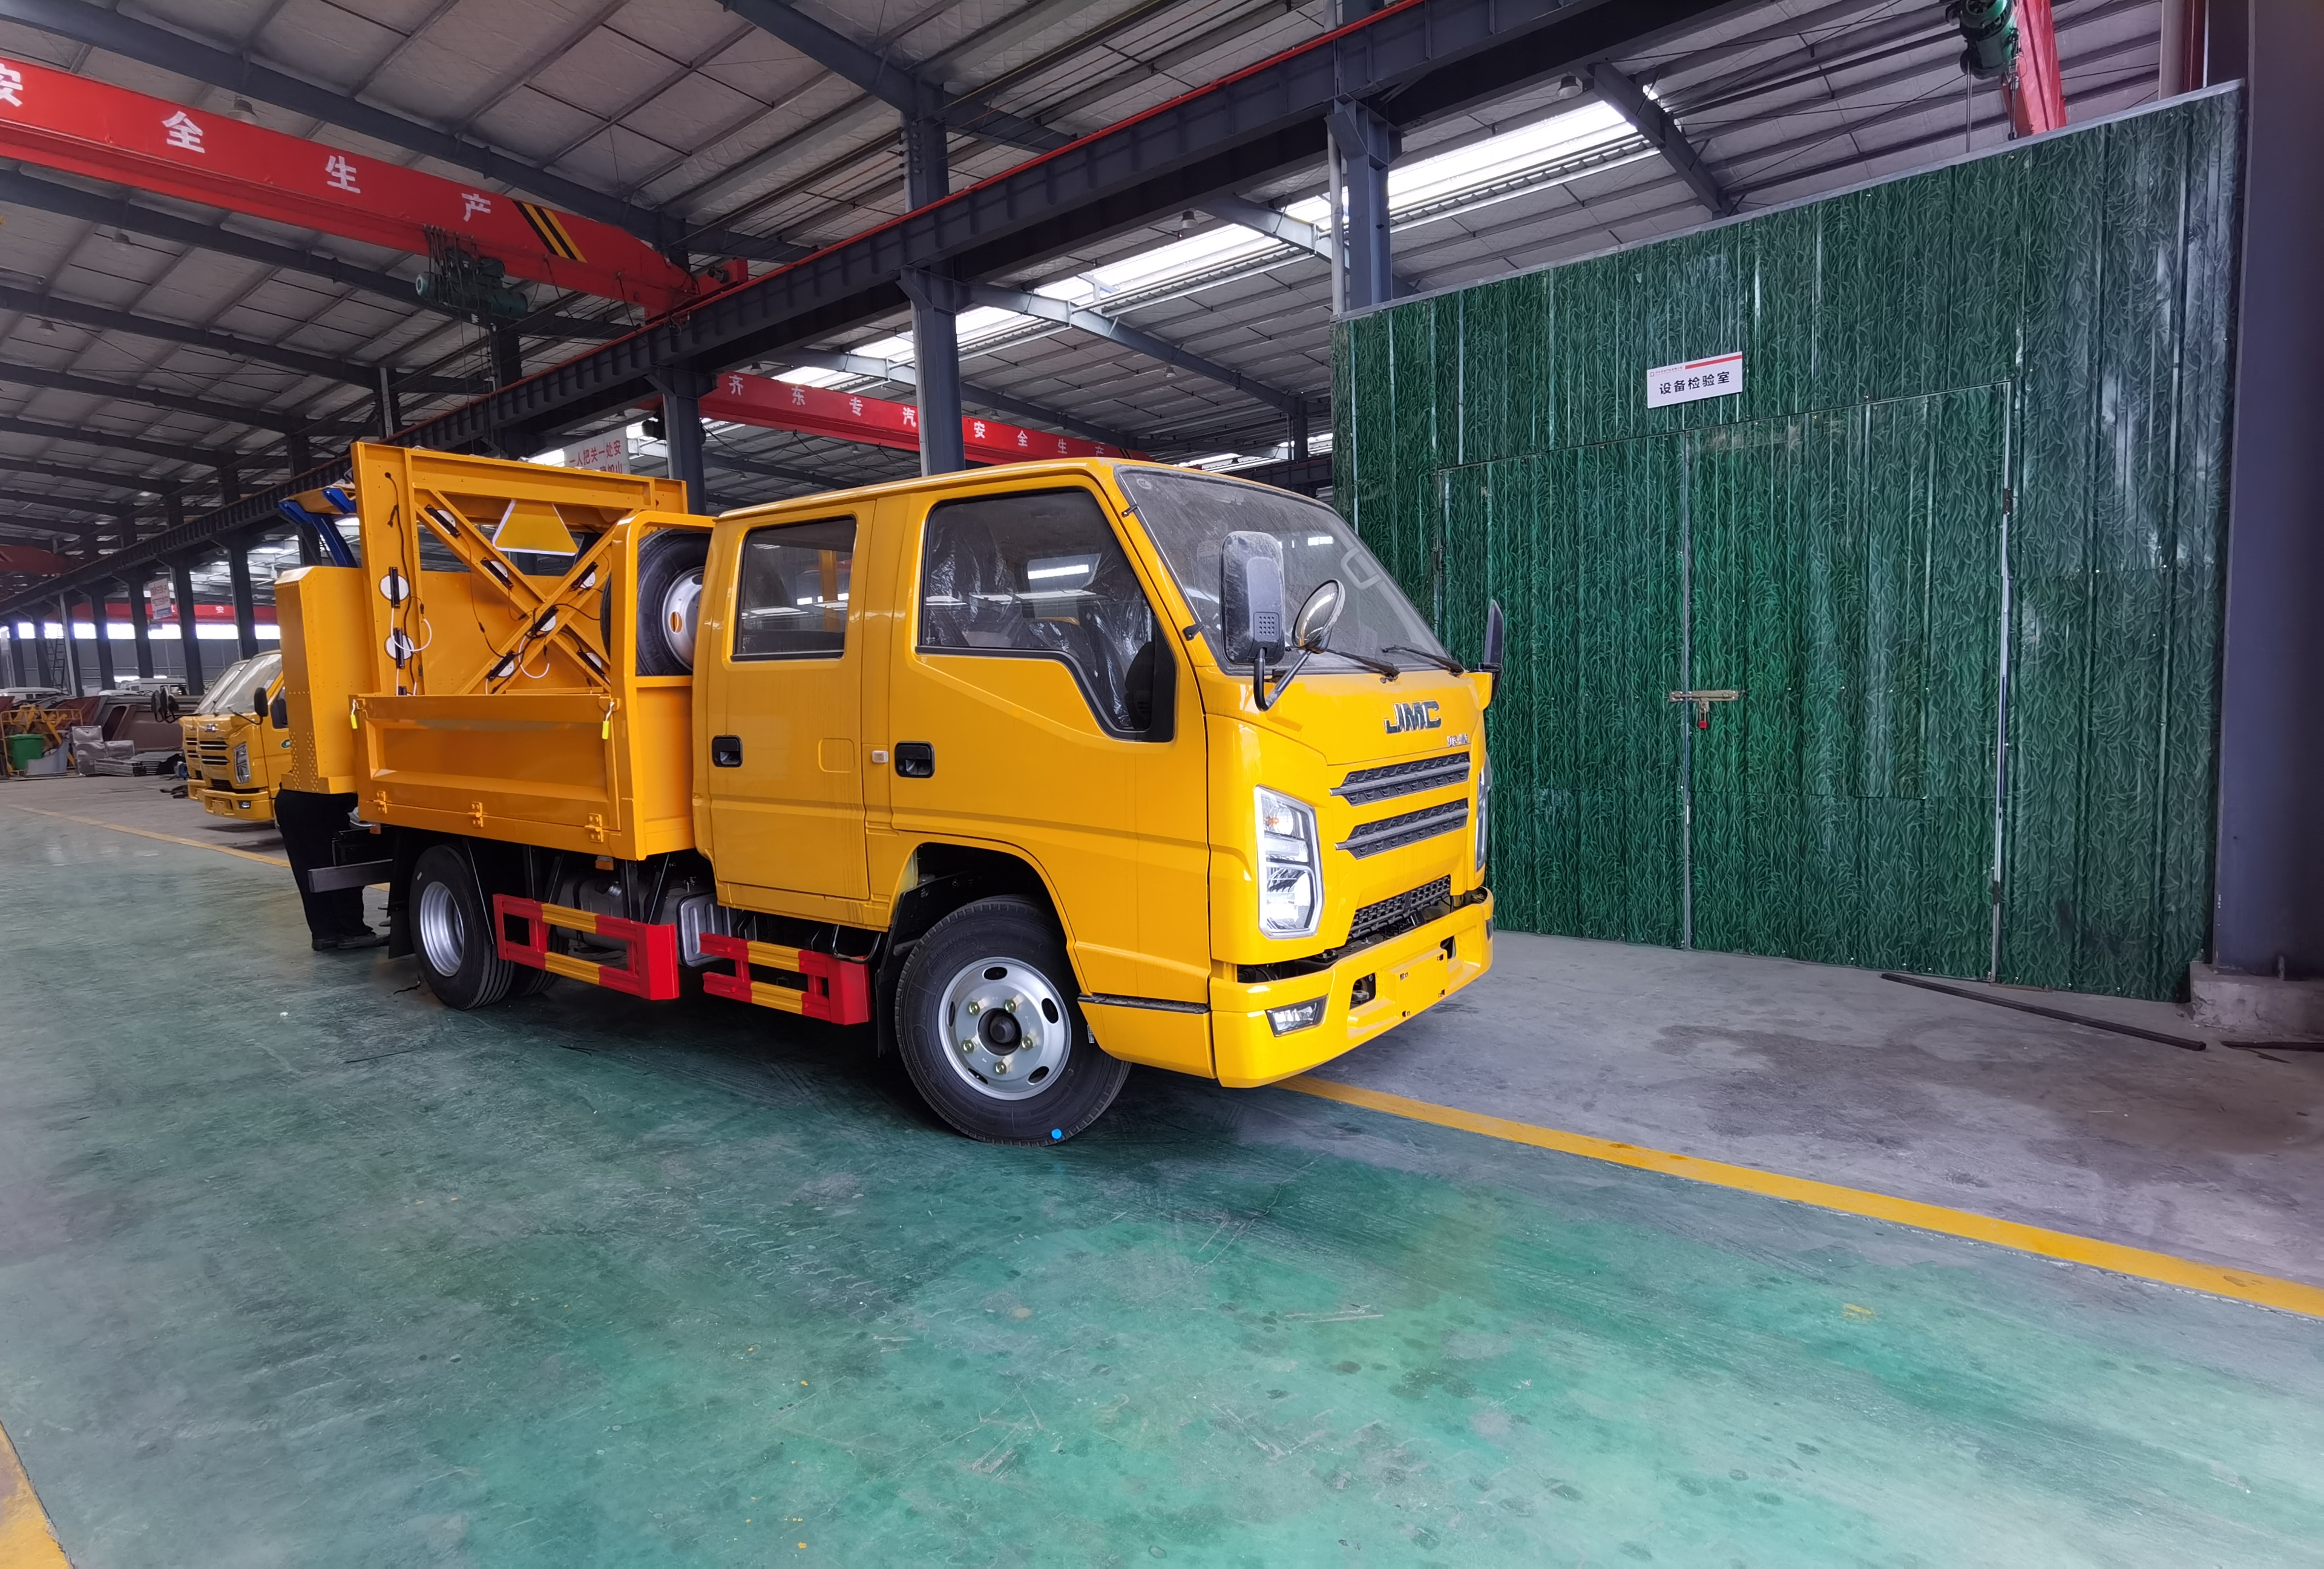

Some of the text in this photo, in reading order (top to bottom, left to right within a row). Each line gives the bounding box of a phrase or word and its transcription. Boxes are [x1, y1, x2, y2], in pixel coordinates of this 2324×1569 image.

[1659, 371, 1730, 395] 设备检验室
[729, 374, 1105, 456] 齐东专汽 安全生产
[569, 439, 621, 466] 一人把关一处安
[1383, 700, 1442, 734] JMC
